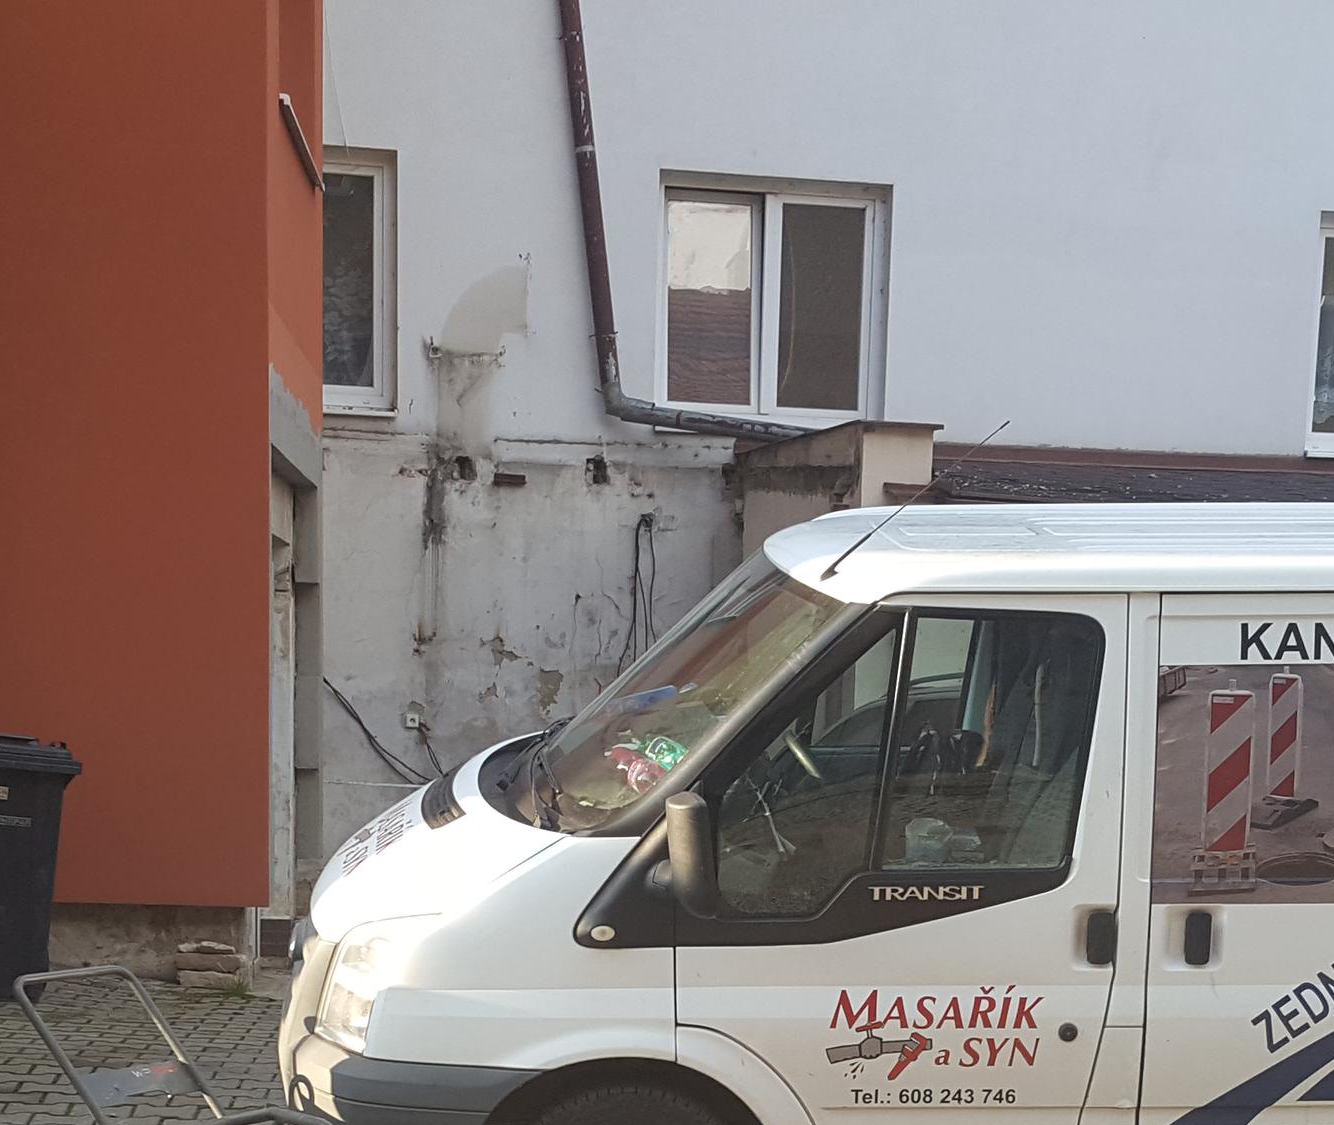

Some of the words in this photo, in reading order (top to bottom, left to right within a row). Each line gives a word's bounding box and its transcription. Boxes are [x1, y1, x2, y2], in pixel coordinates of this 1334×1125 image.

[867, 885, 985, 901] TRANSIT
[829, 985, 1046, 1030] MASAŘÍK
[934, 1048, 951, 1066] a
[958, 1037, 1041, 1067] SYN
[850, 1088, 892, 1105] Tel.:
[898, 1088, 934, 1105] 608
[939, 1088, 975, 1105] 243
[982, 1088, 1017, 1105] 746
